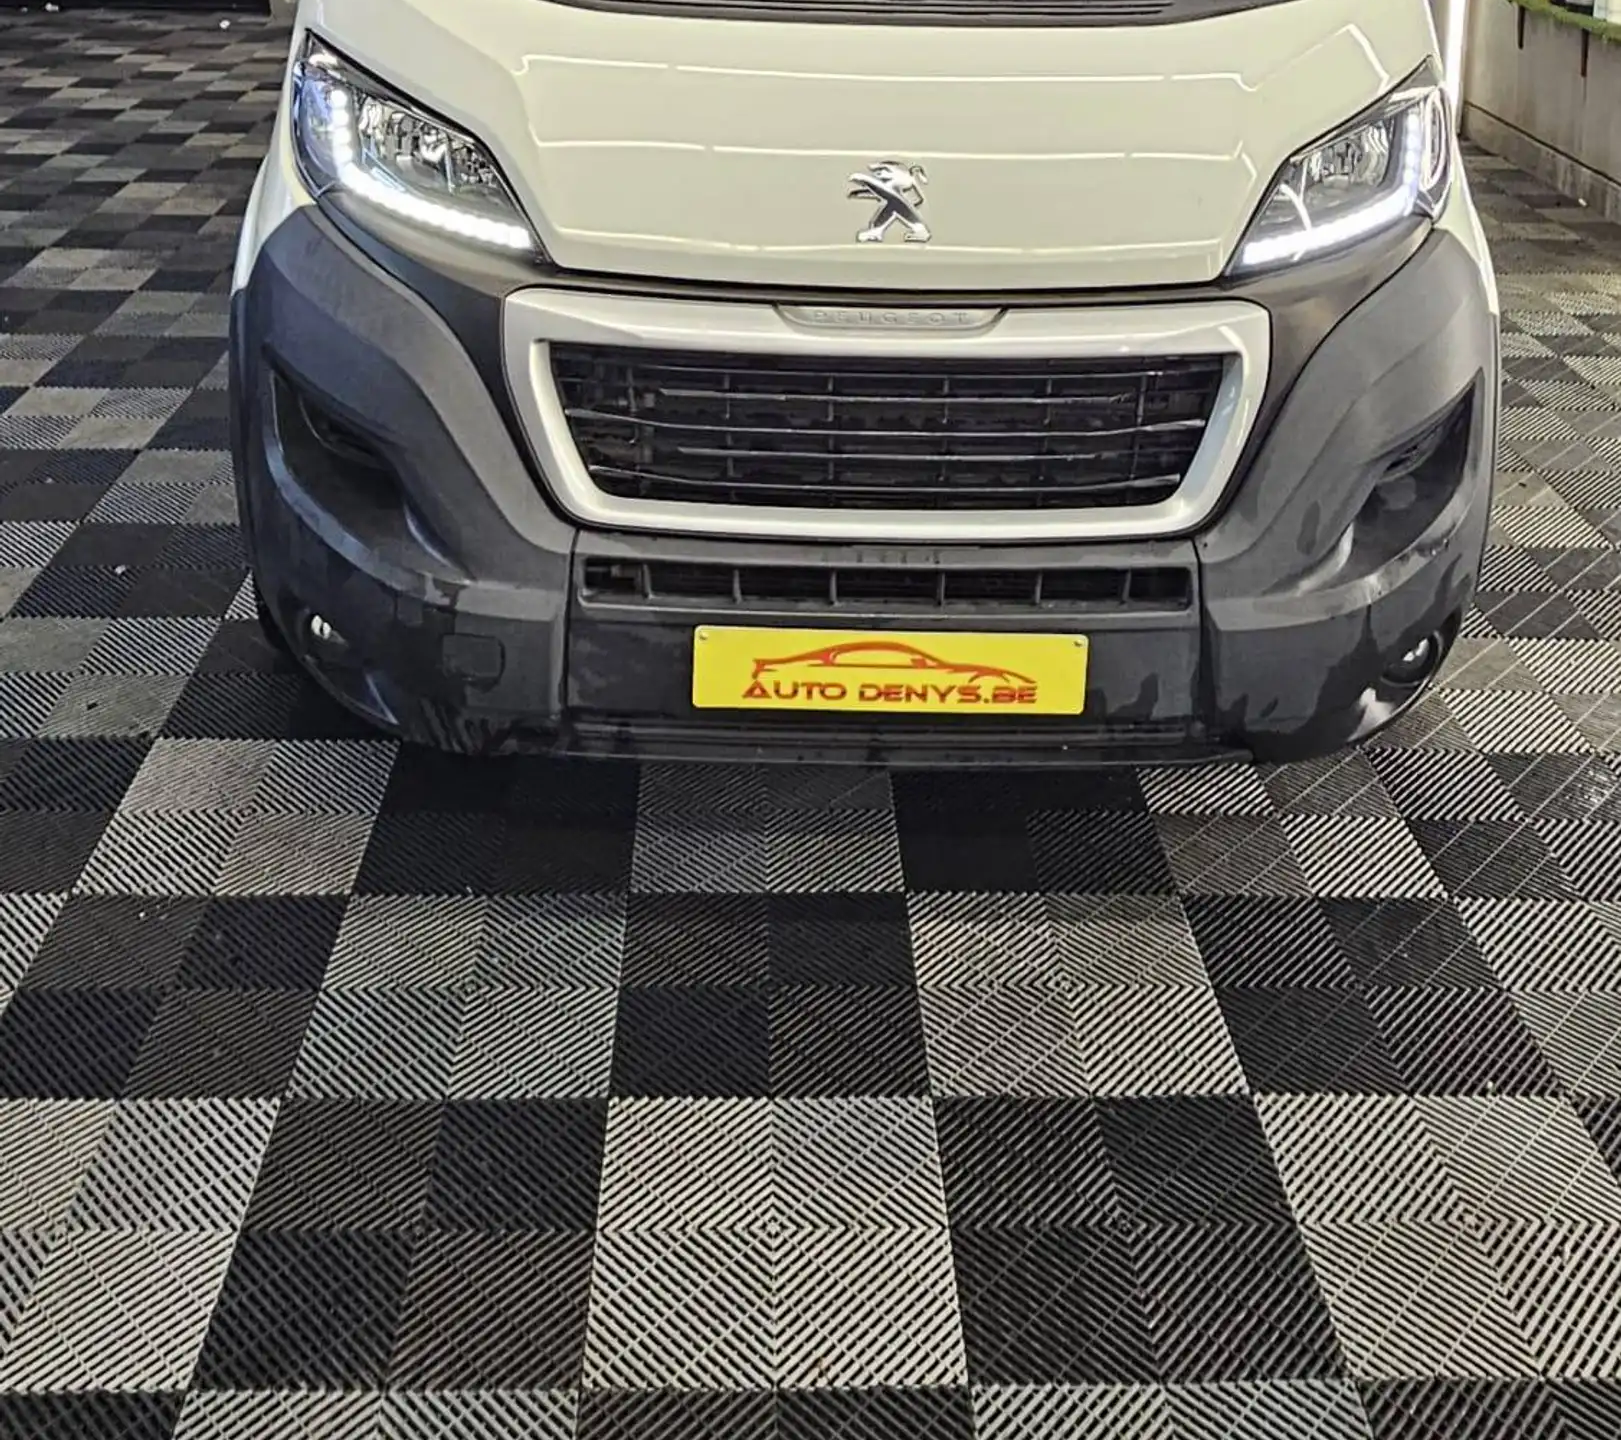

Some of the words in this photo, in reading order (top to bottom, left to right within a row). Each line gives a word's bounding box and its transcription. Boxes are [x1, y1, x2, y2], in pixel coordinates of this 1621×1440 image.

[814, 310, 968, 324] PEUGEOT
[743, 679, 848, 701] AUTO
[858, 683, 1038, 704] DENYS.BE
